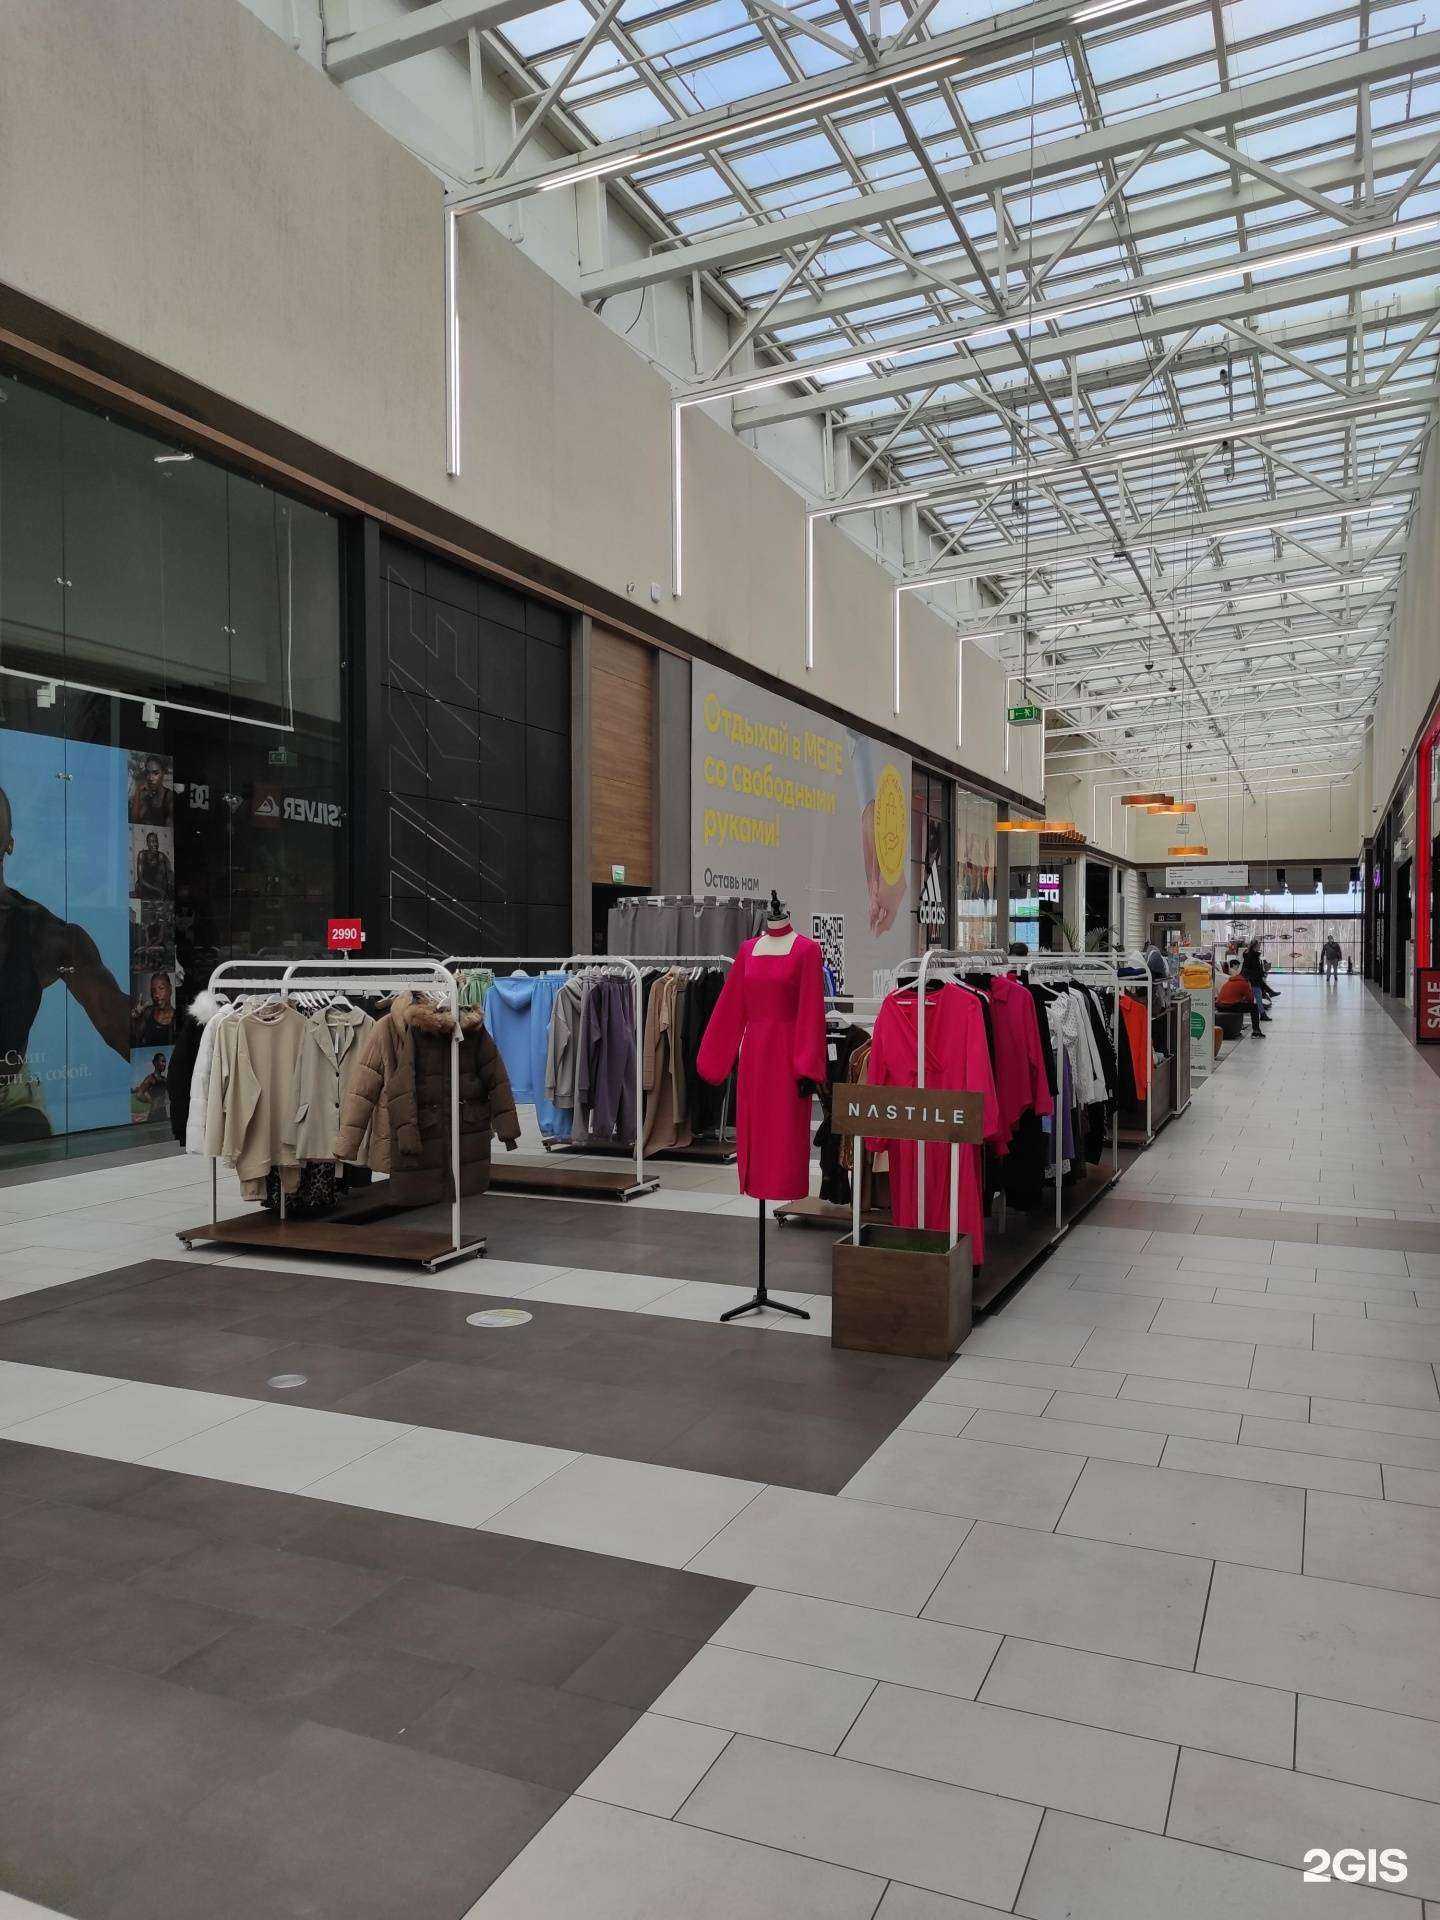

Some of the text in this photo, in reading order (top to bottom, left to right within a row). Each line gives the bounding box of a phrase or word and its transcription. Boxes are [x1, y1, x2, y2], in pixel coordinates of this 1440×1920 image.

[704, 692, 844, 776] Отдыхай в МЕГЕ
[704, 755, 727, 790] со
[733, 763, 837, 815] свободными
[704, 809, 781, 848] руками!
[704, 867, 760, 891] Оставь нам
[920, 899, 946, 924] adidas
[332, 927, 357, 940] 2990
[848, 1102, 965, 1124] NASTILE
